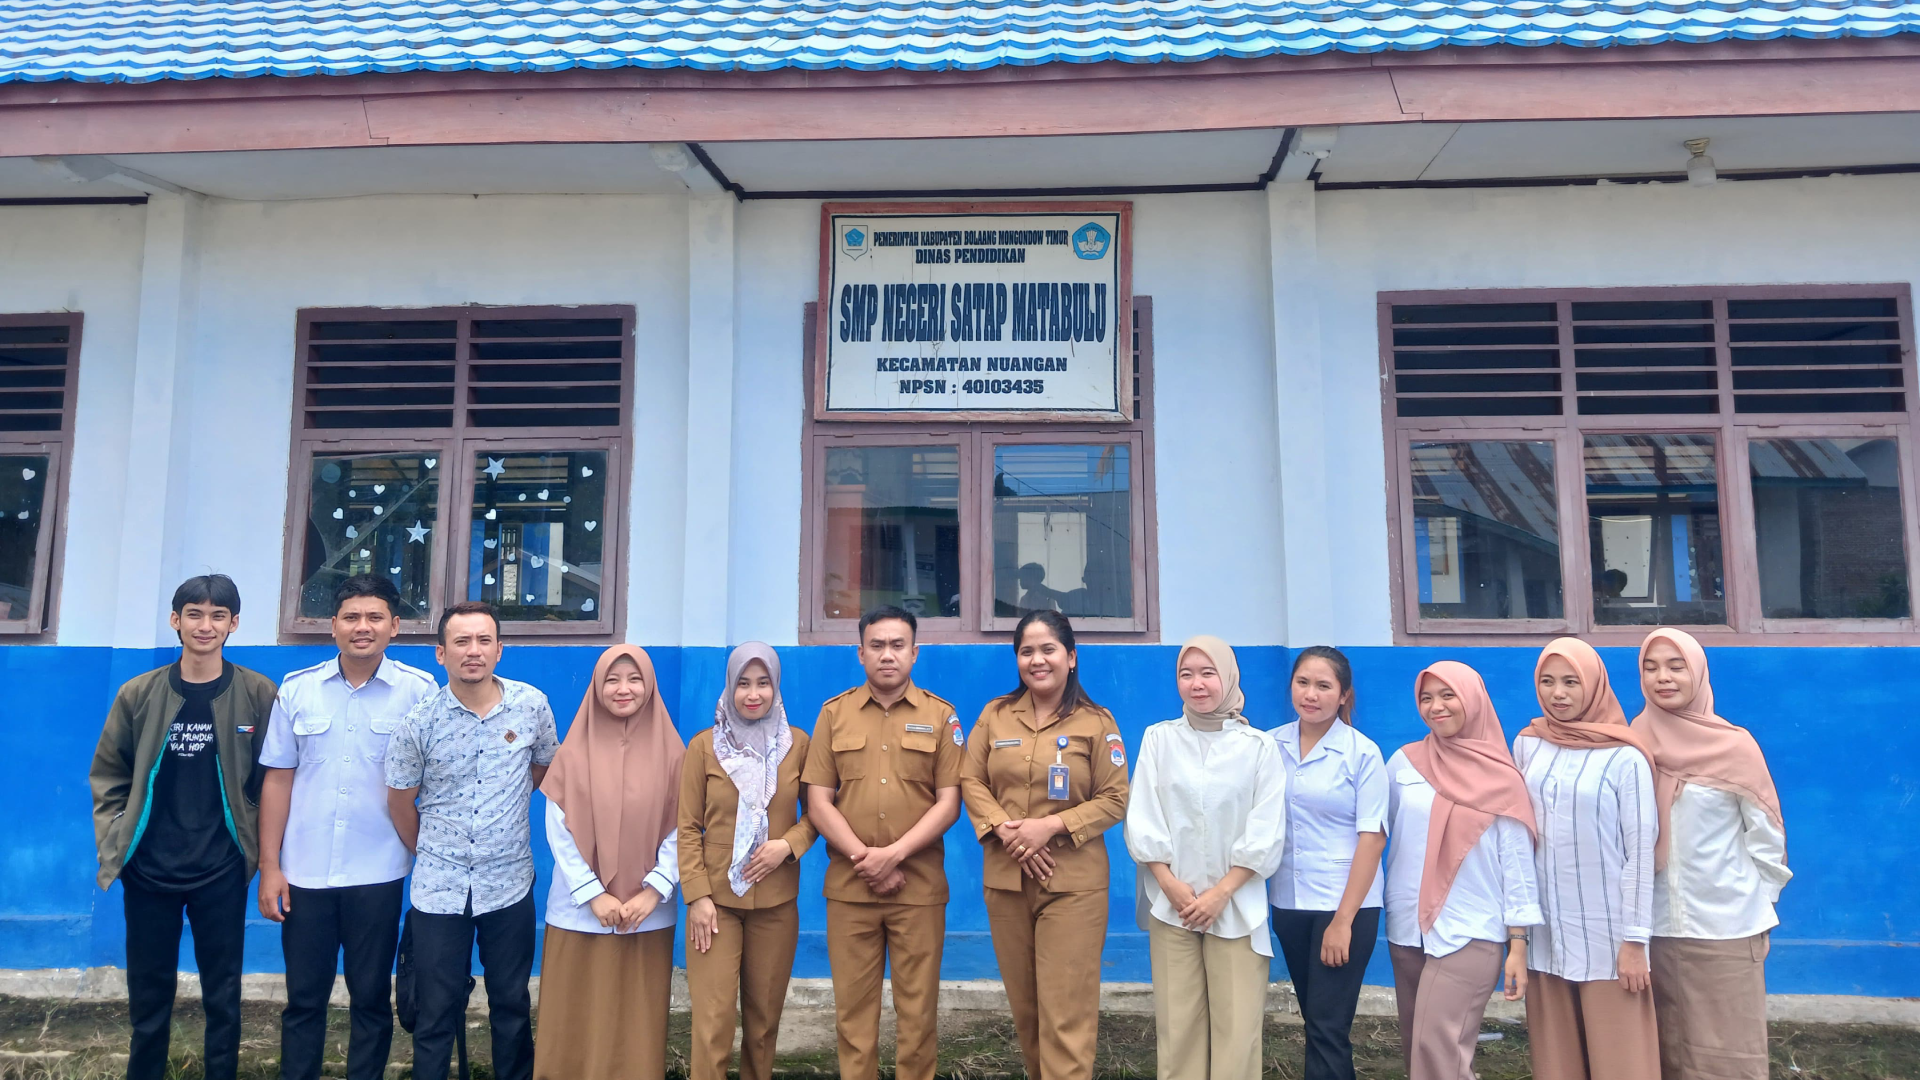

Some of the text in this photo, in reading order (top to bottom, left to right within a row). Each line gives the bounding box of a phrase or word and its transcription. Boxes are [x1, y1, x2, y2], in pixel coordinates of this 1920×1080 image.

[873, 231, 919, 247] PEMERINTAH
[920, 231, 962, 246] KABUPATEN
[964, 230, 997, 246] BOLAANG
[998, 230, 1044, 246] MONGONDOW
[1045, 230, 1069, 246] TIMUR
[915, 247, 1026, 264] DINAS PENDIDIKAN
[839, 282, 1107, 343] SMP NEGERI SATAP MATABULU
[876, 356, 1068, 372] KECAMATAN NUANGAN
[899, 379, 947, 394] NPSN
[961, 379, 1044, 394] 40103435
[186, 722, 213, 732] KANAN
[181, 732, 214, 743] MUNDUR
[170, 742, 206, 752] YAA HOP
